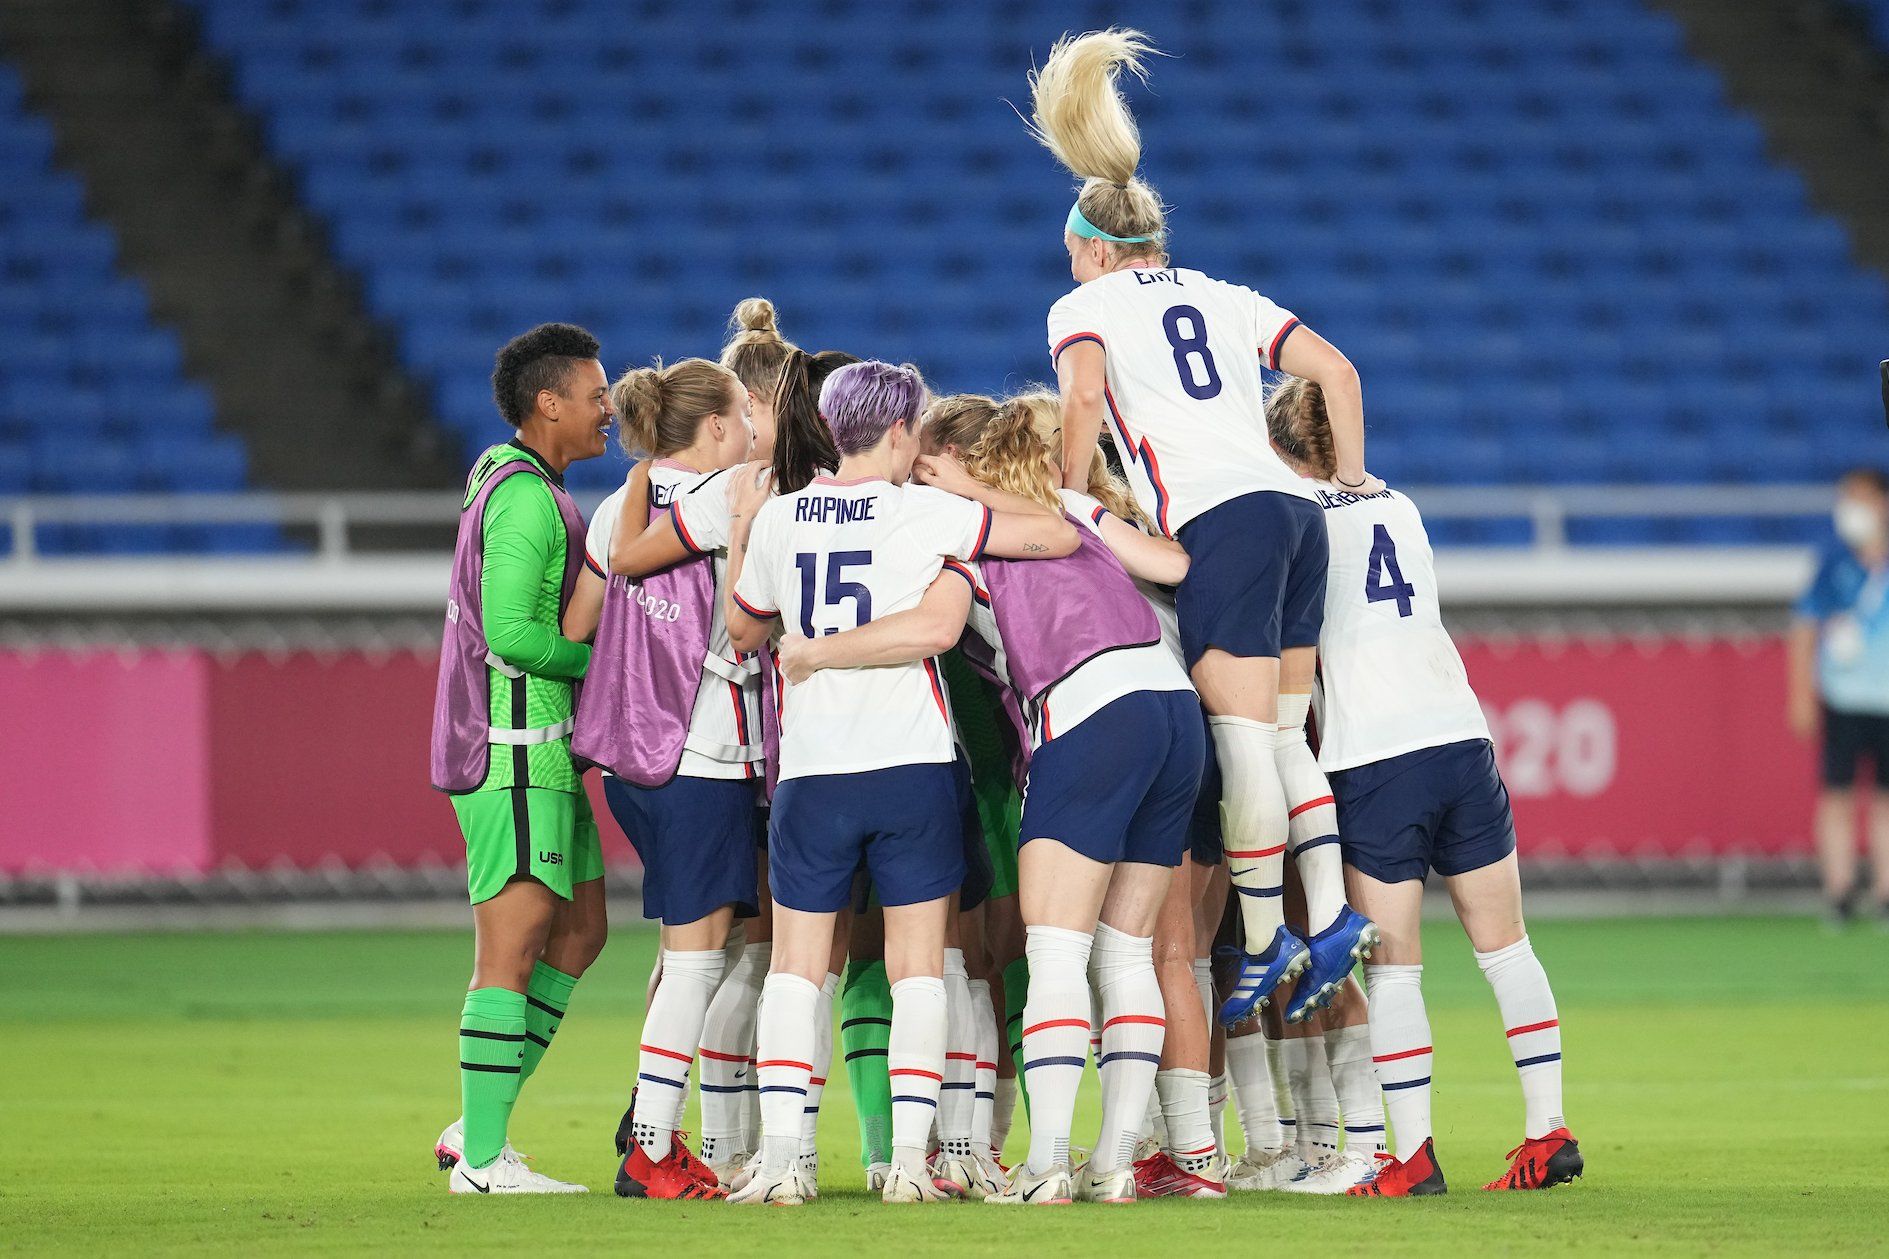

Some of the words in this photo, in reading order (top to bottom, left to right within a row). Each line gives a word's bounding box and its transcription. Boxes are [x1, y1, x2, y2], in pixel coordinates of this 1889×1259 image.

[1162, 304, 1222, 401] 8
[795, 496, 878, 524] RAPINOE
[795, 550, 873, 639] 15
[1365, 524, 1416, 618] 4
[539, 851, 564, 866] USA
